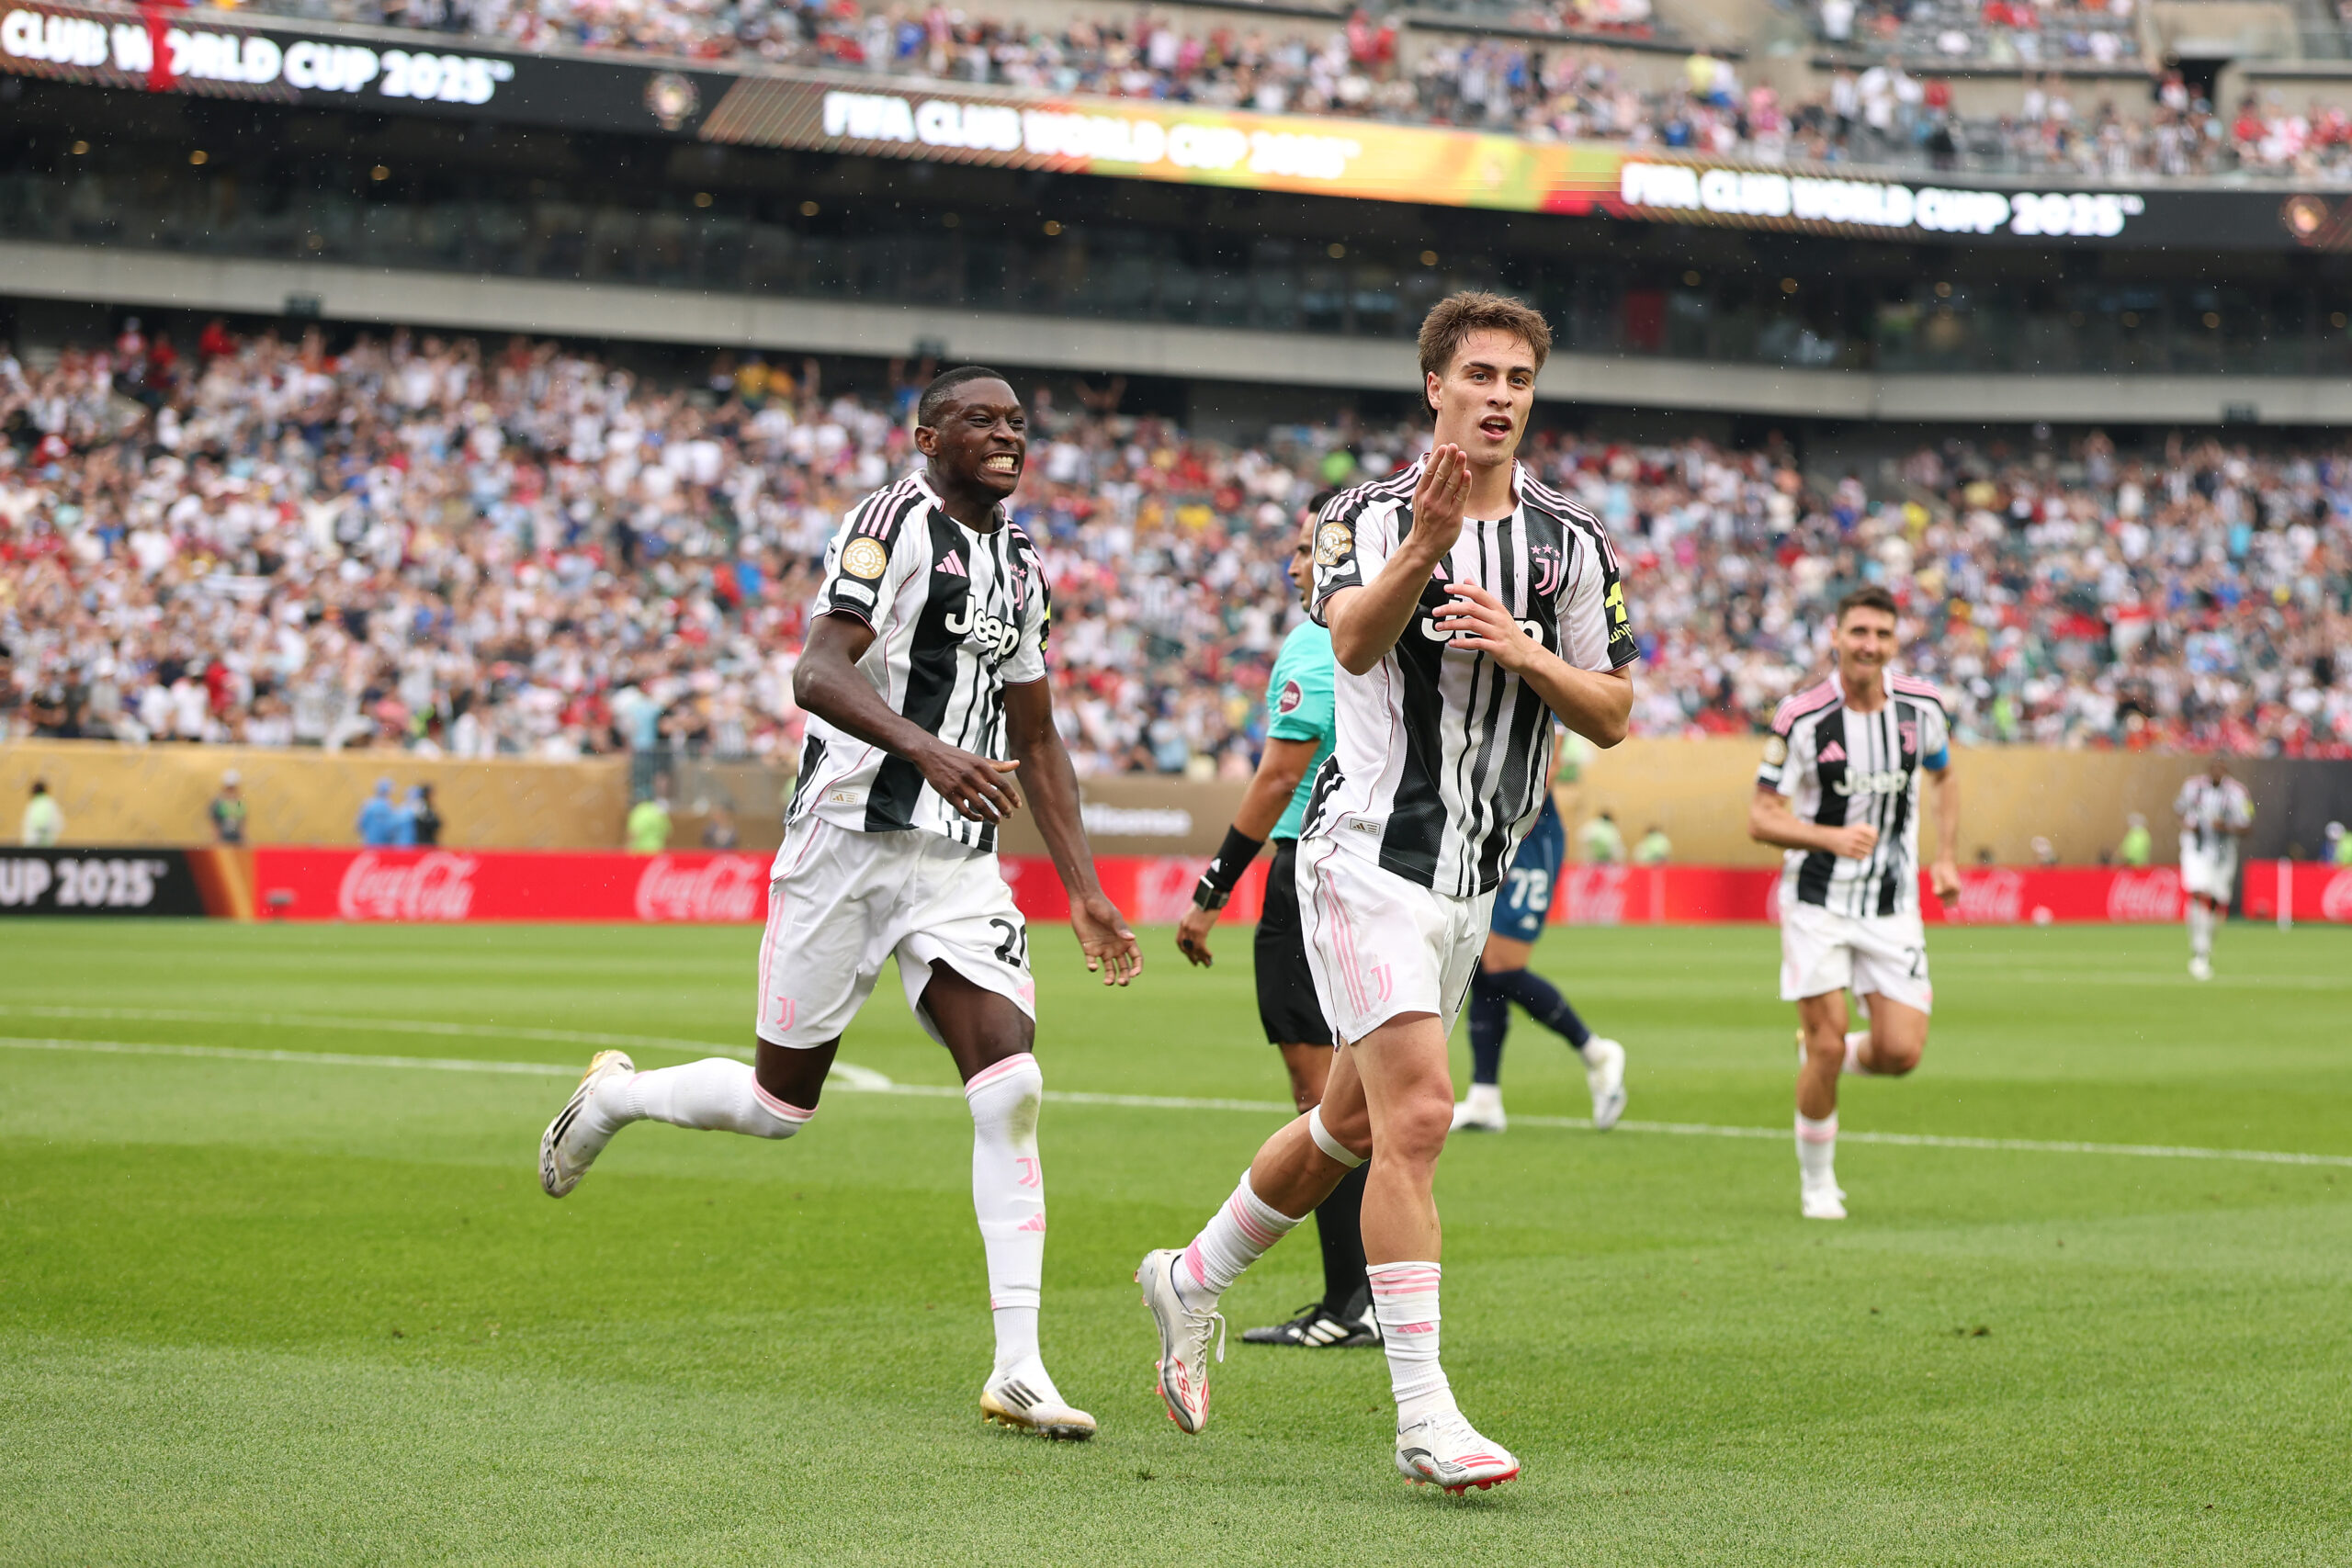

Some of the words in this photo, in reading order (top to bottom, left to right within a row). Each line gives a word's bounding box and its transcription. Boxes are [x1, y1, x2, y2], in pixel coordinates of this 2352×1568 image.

[1, 8, 108, 66] CLUB
[283, 39, 379, 93] CUP
[944, 594, 1020, 660] Jeep
[1832, 766, 1909, 797] Jeep
[1509, 867, 1549, 911] 72
[1171, 1354, 1196, 1413] F50
